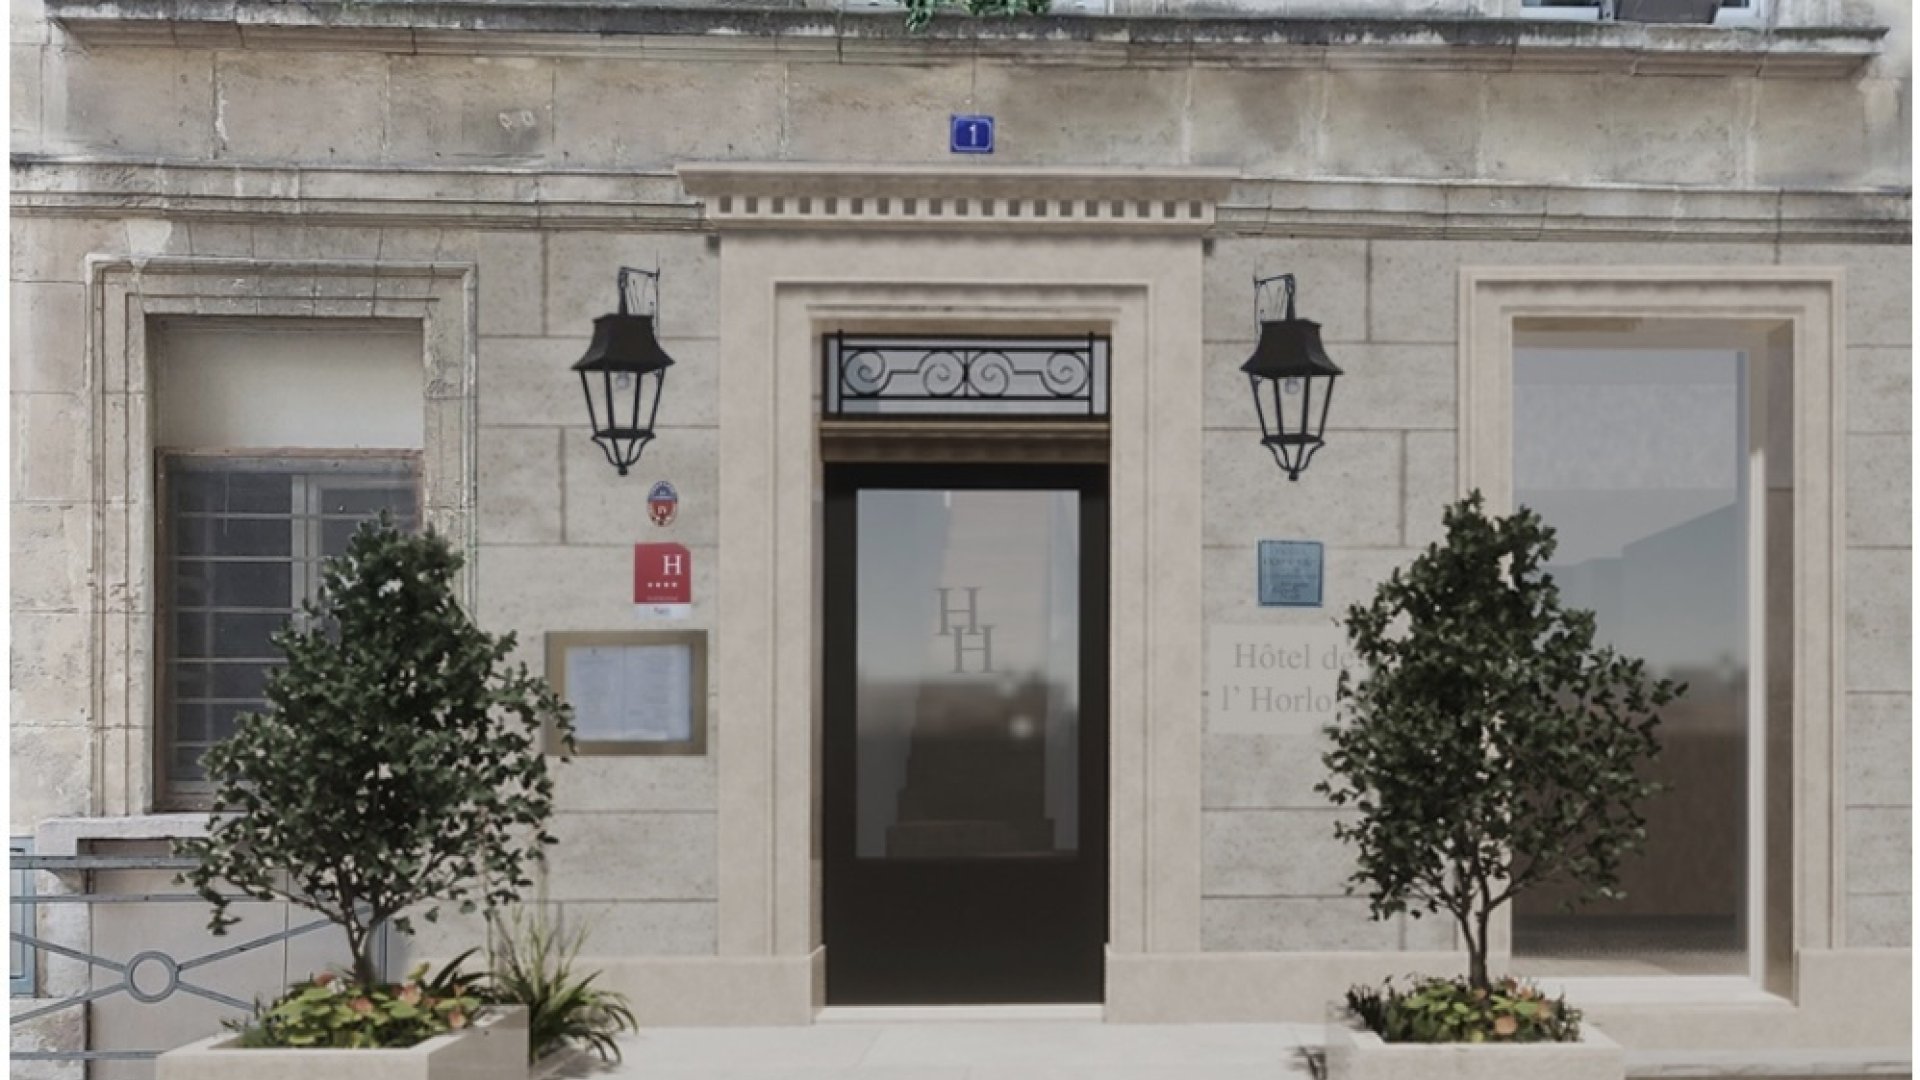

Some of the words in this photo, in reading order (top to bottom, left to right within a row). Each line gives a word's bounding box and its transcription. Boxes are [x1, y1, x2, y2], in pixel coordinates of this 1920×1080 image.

[969, 123, 976, 145] 1
[663, 553, 682, 576] H
[1233, 642, 1311, 670] Hôtel
[1321, 643, 1355, 671] de
[1250, 684, 1334, 713] Horlo
